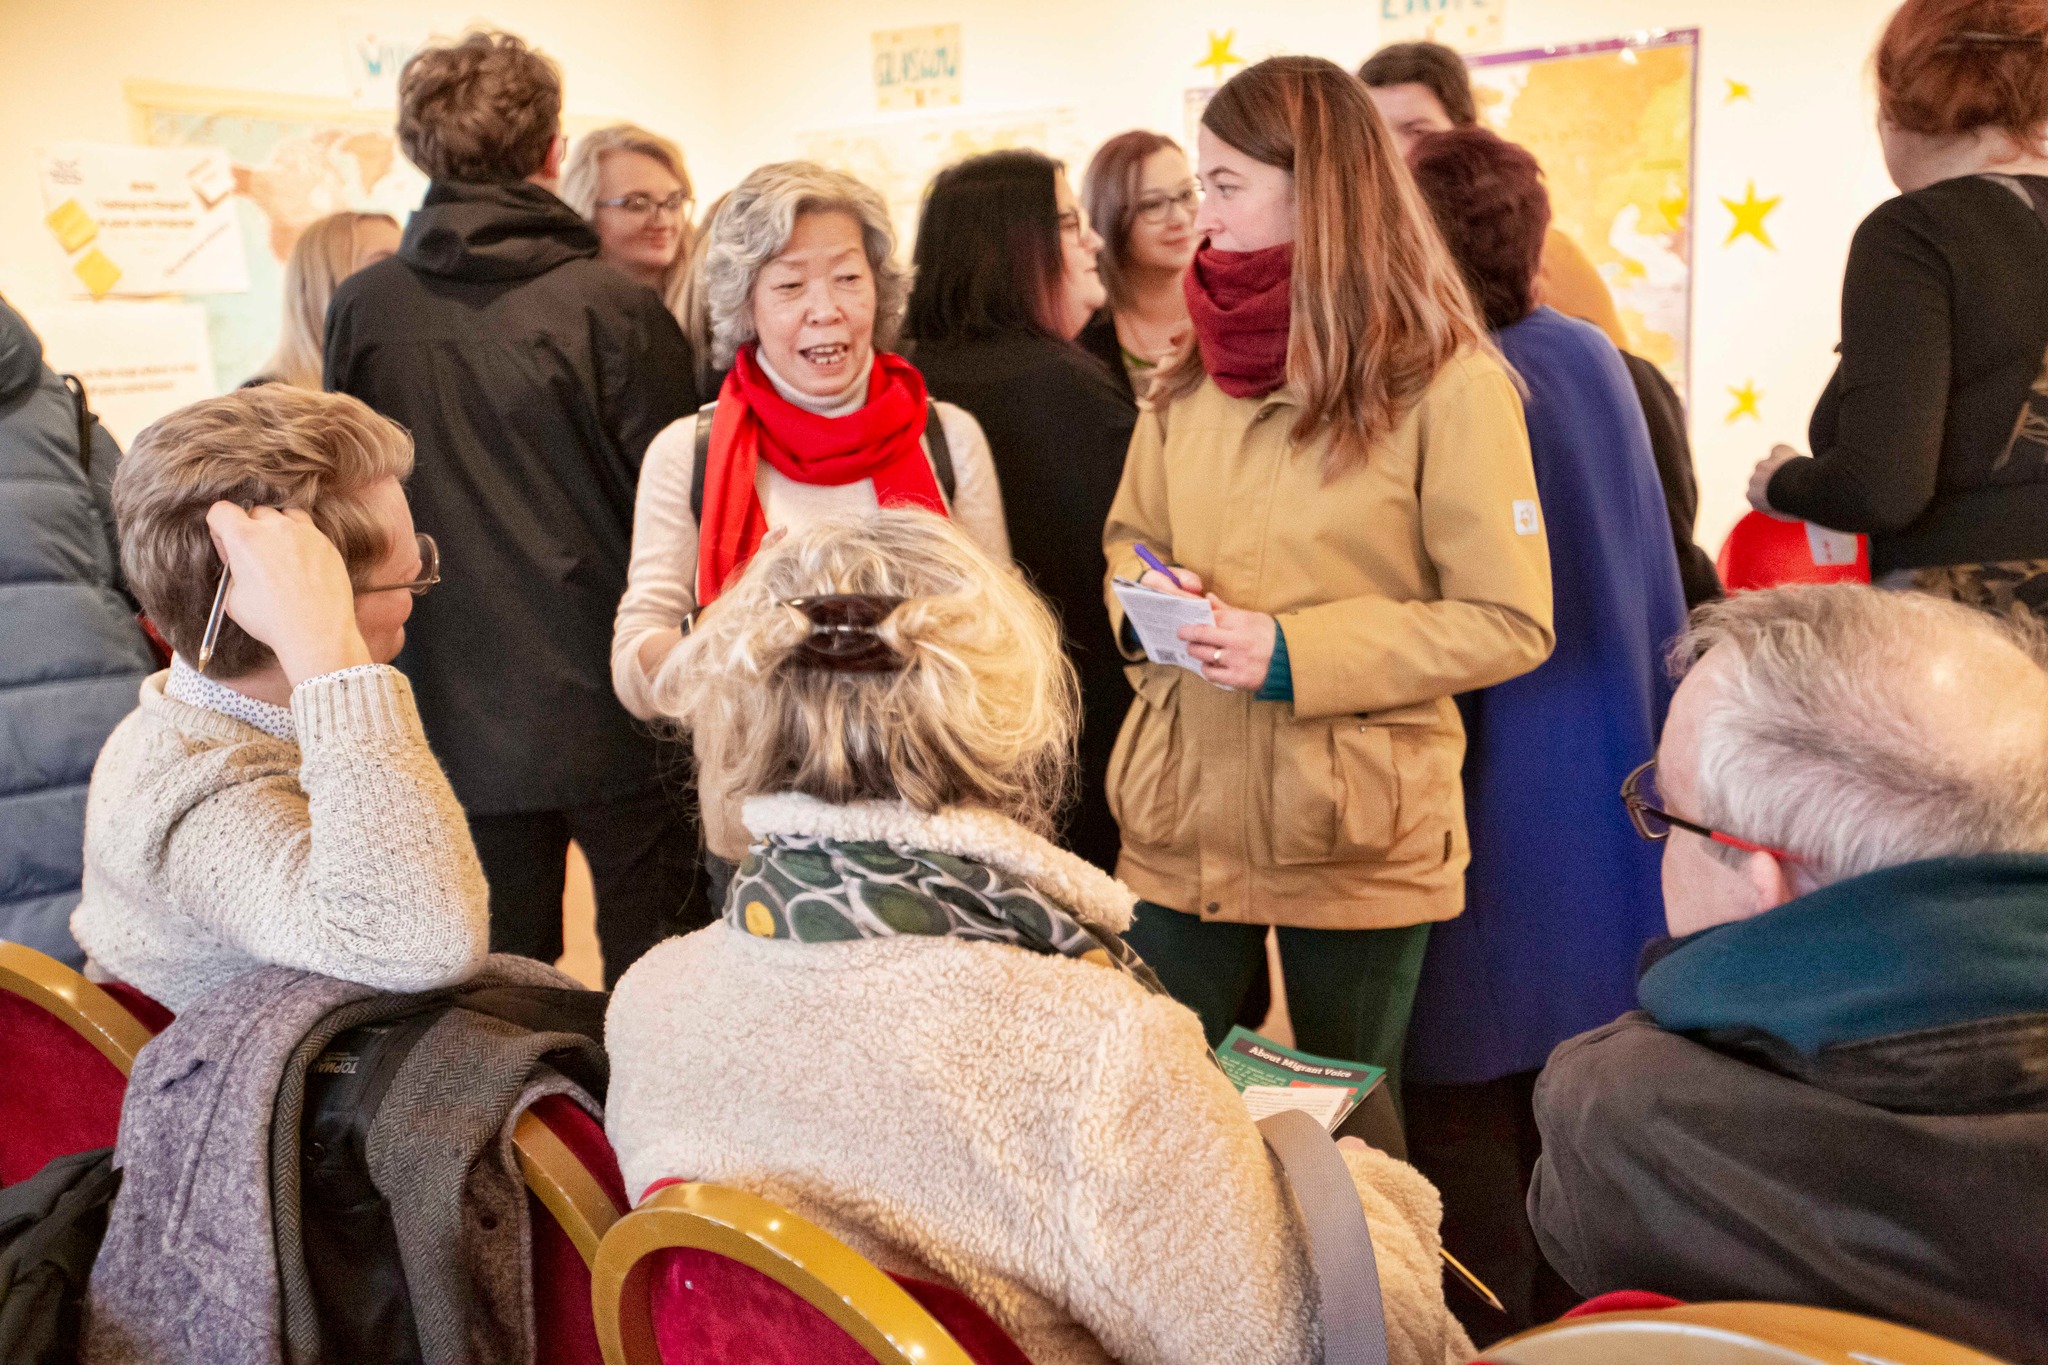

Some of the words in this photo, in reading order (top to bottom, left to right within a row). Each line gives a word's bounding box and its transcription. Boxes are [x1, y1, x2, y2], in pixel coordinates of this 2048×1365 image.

[1249, 1046, 1281, 1064] About
[1281, 1058, 1324, 1075] Migrant
[1324, 1067, 1352, 1078] Voice
